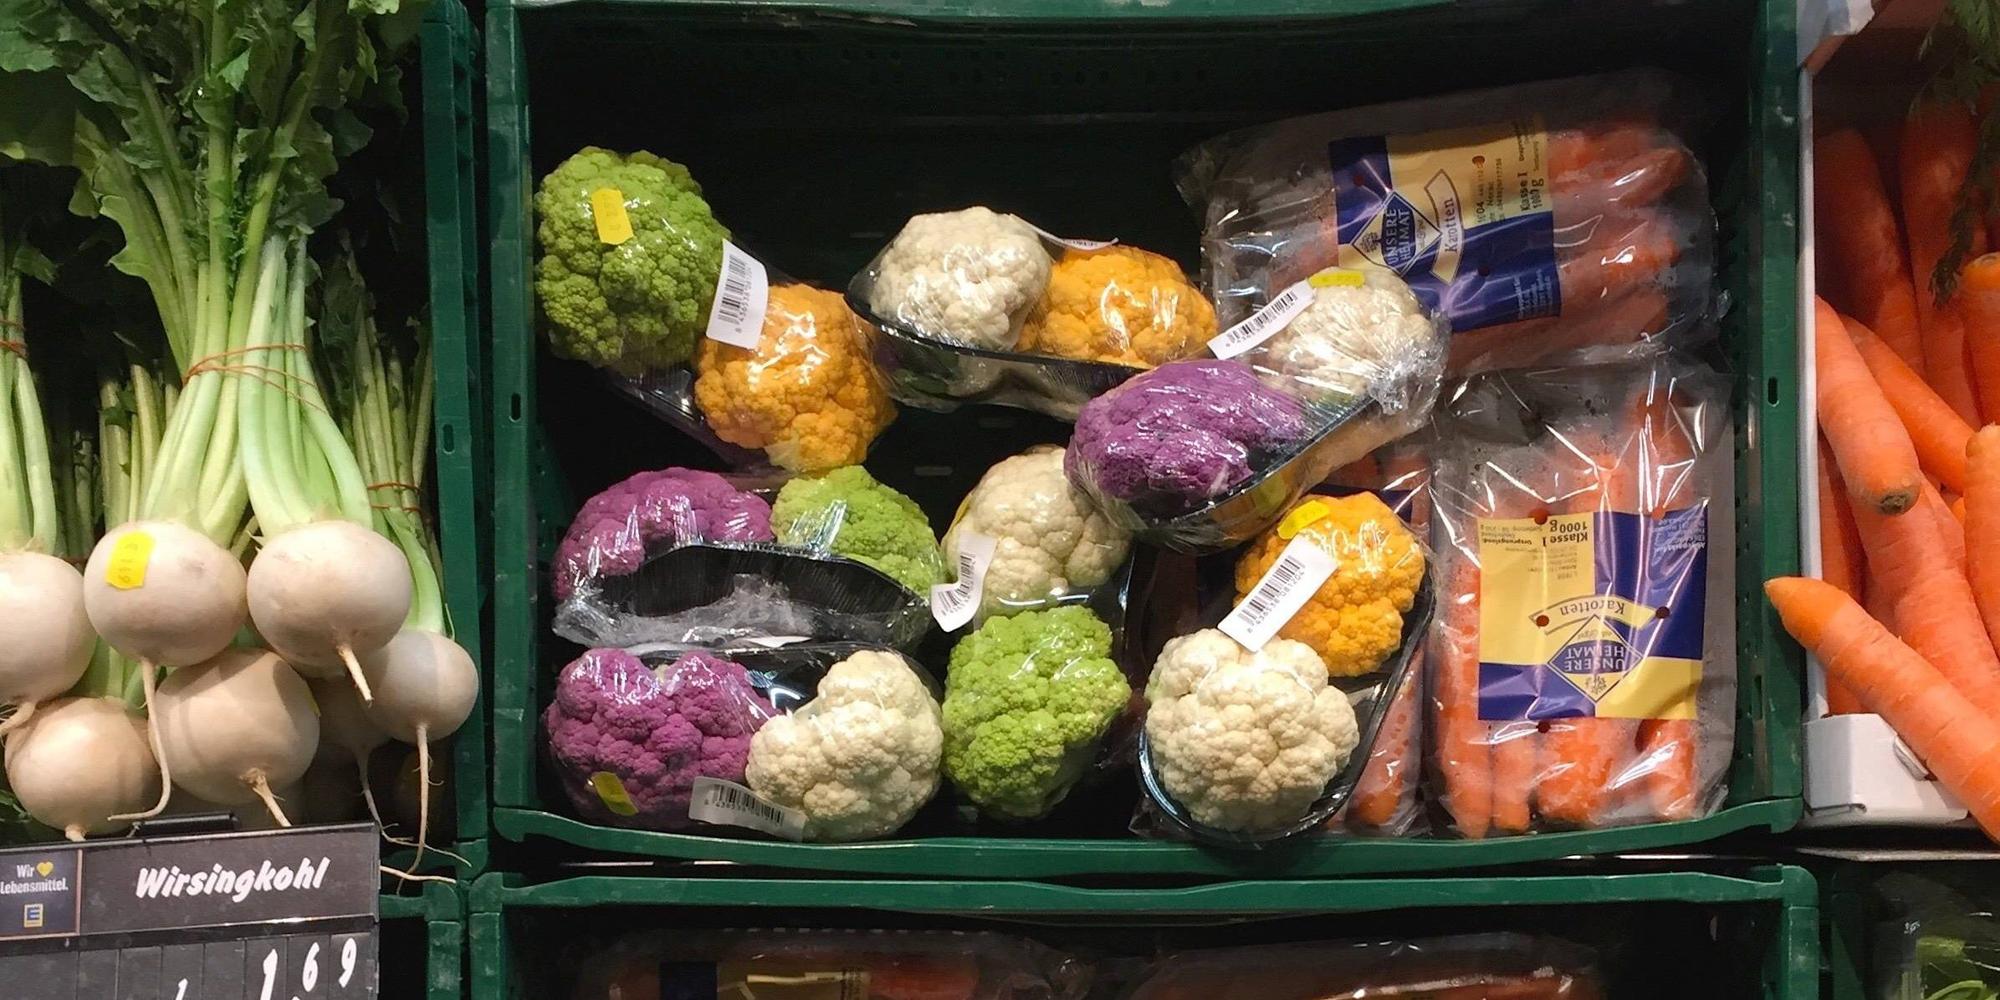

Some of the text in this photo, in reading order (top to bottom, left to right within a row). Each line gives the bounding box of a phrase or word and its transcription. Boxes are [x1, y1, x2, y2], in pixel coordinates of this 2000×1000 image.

[1443, 197, 1459, 254] Karotten
[1385, 207, 1398, 266] UNSERE
[1397, 208, 1412, 262] HEIMAT
[1549, 519, 1558, 532] g
[1559, 521, 1588, 533] 1000
[1550, 531, 1589, 544] Klasse
[1560, 599, 1625, 616] Karotten
[1565, 645, 1625, 657] HEIMAT
[1564, 658, 1625, 672] UNSERE
[16, 864, 35, 879] Wir
[0, 878, 69, 895] Lebensmittel.
[136, 857, 331, 903] Wirsingkohl
